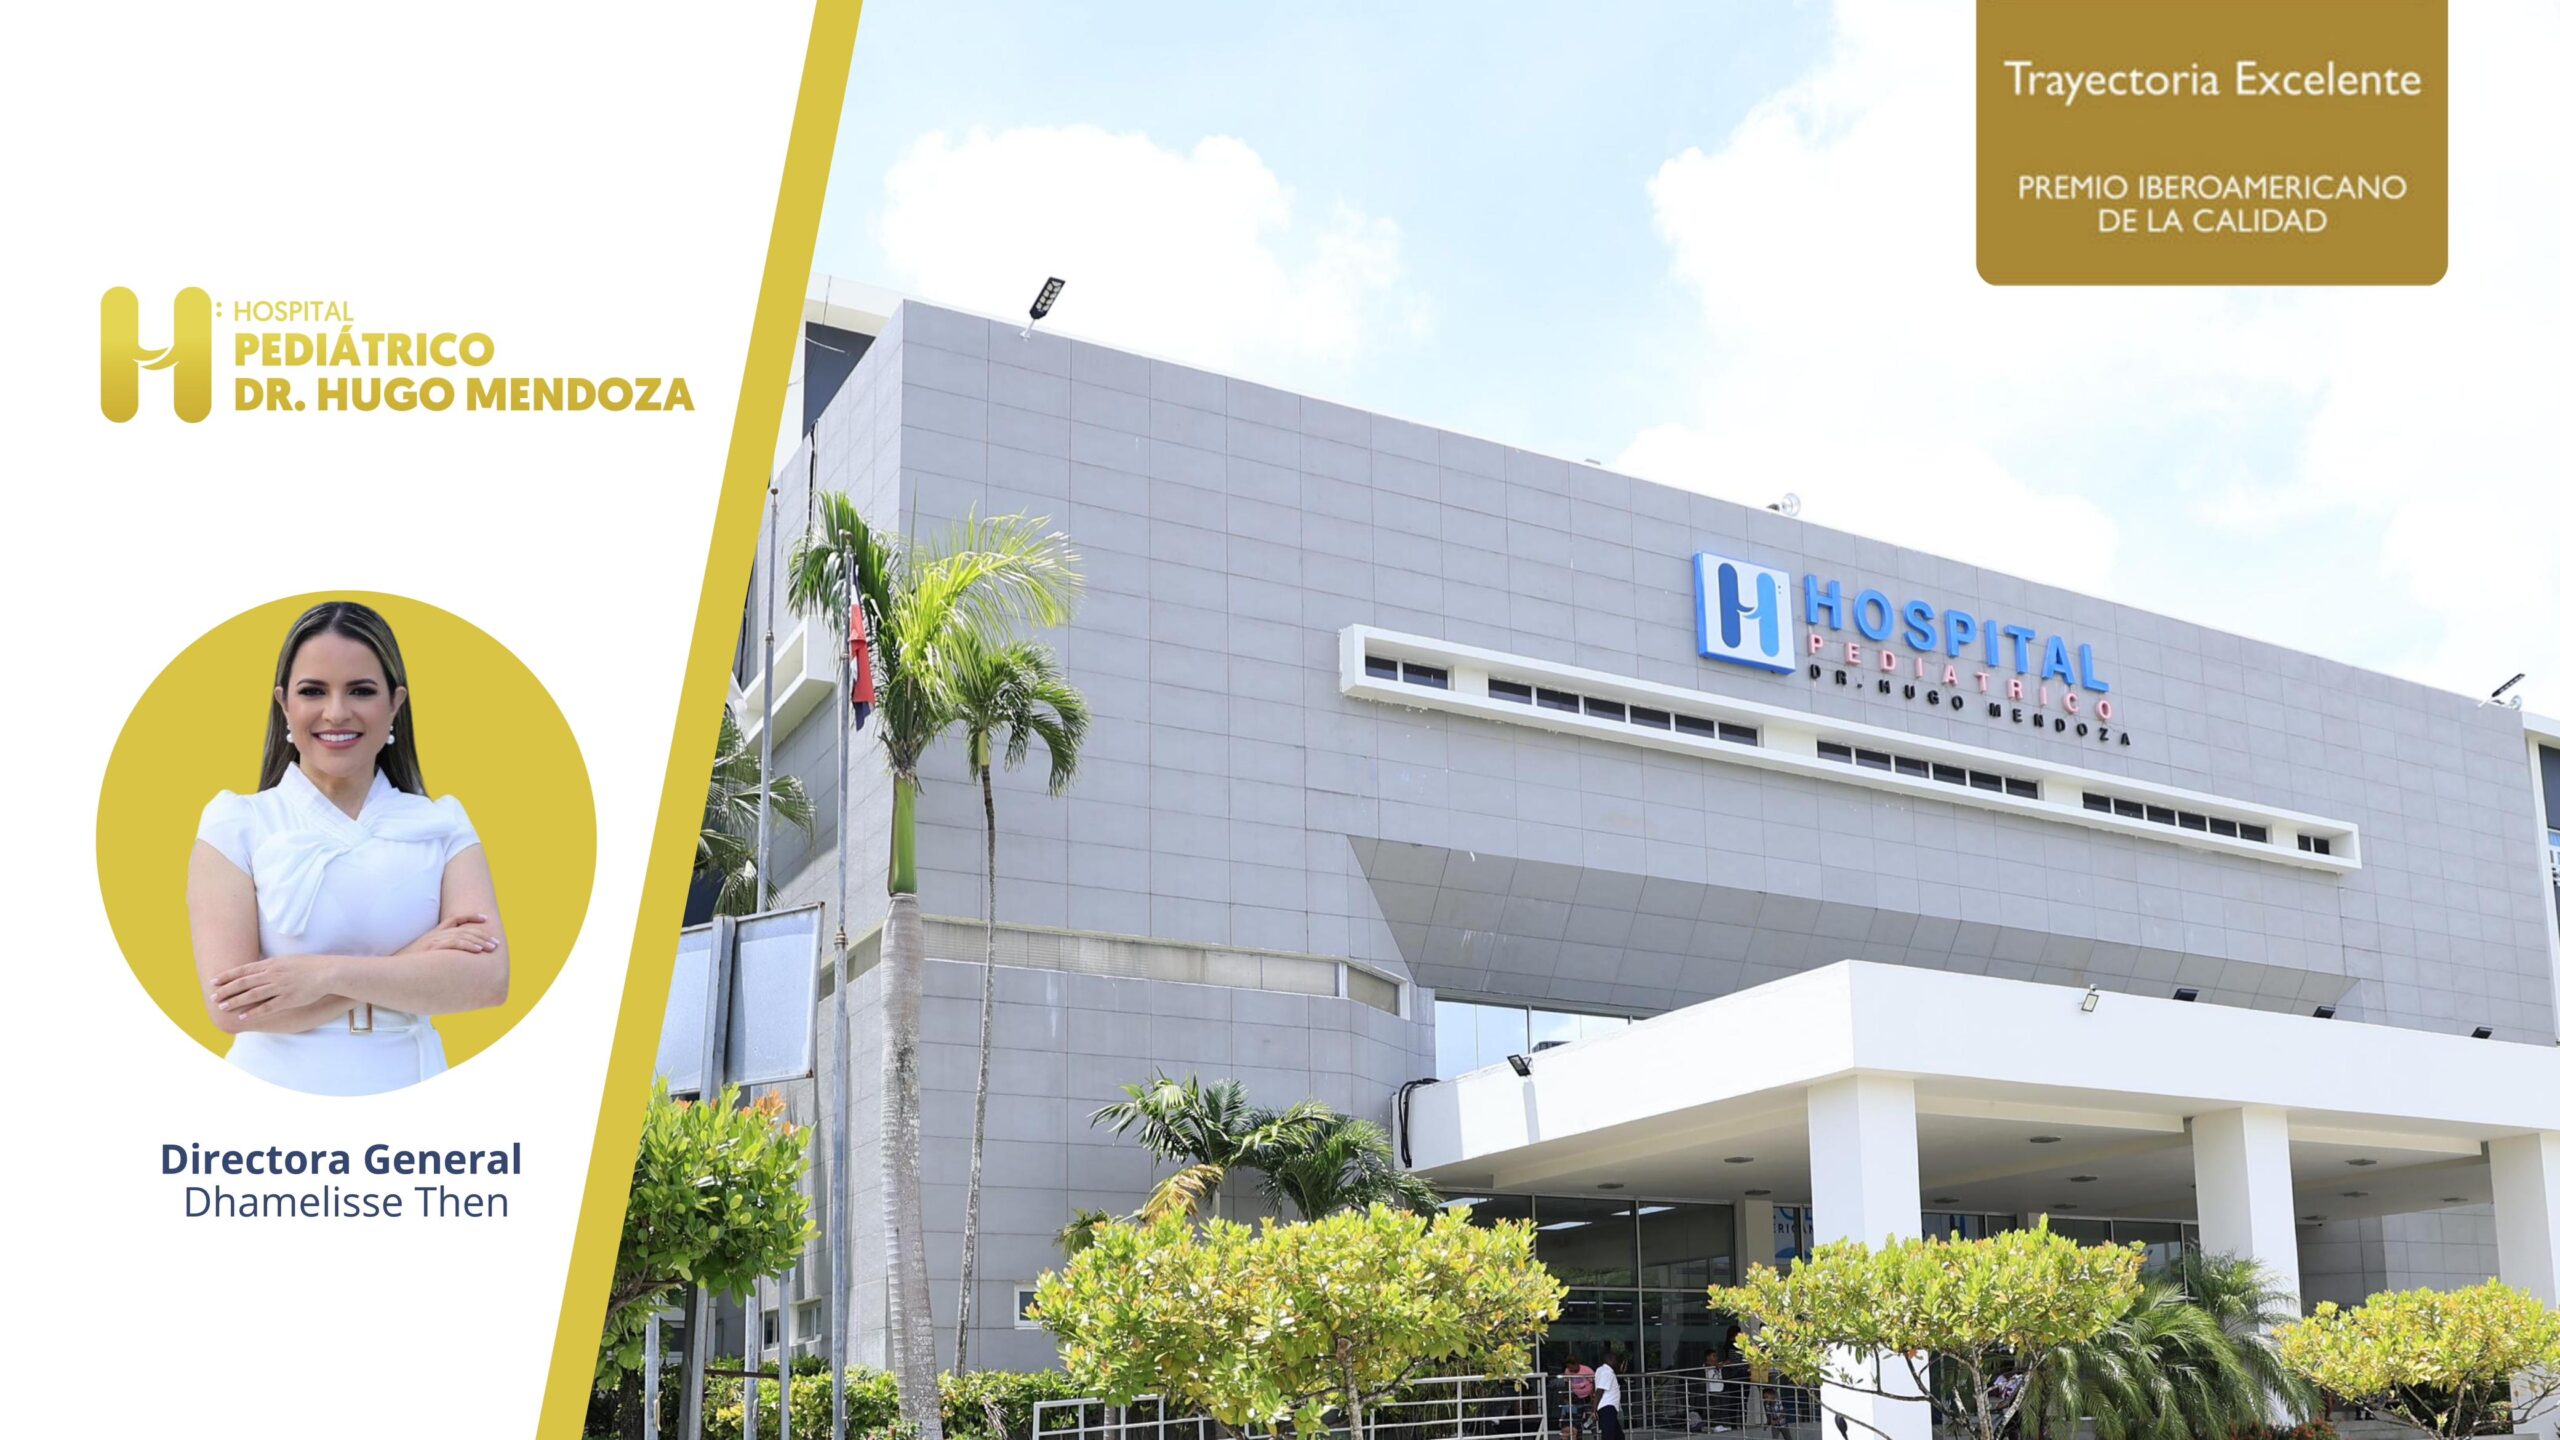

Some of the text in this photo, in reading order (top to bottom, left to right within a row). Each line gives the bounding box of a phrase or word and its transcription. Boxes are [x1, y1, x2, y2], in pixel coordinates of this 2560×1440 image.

[1803, 574, 2111, 693] HOSPITAL
[1808, 632, 2113, 720] PEDIATRICO
[1810, 664, 2131, 747] DR. HUGO MENDOZA
